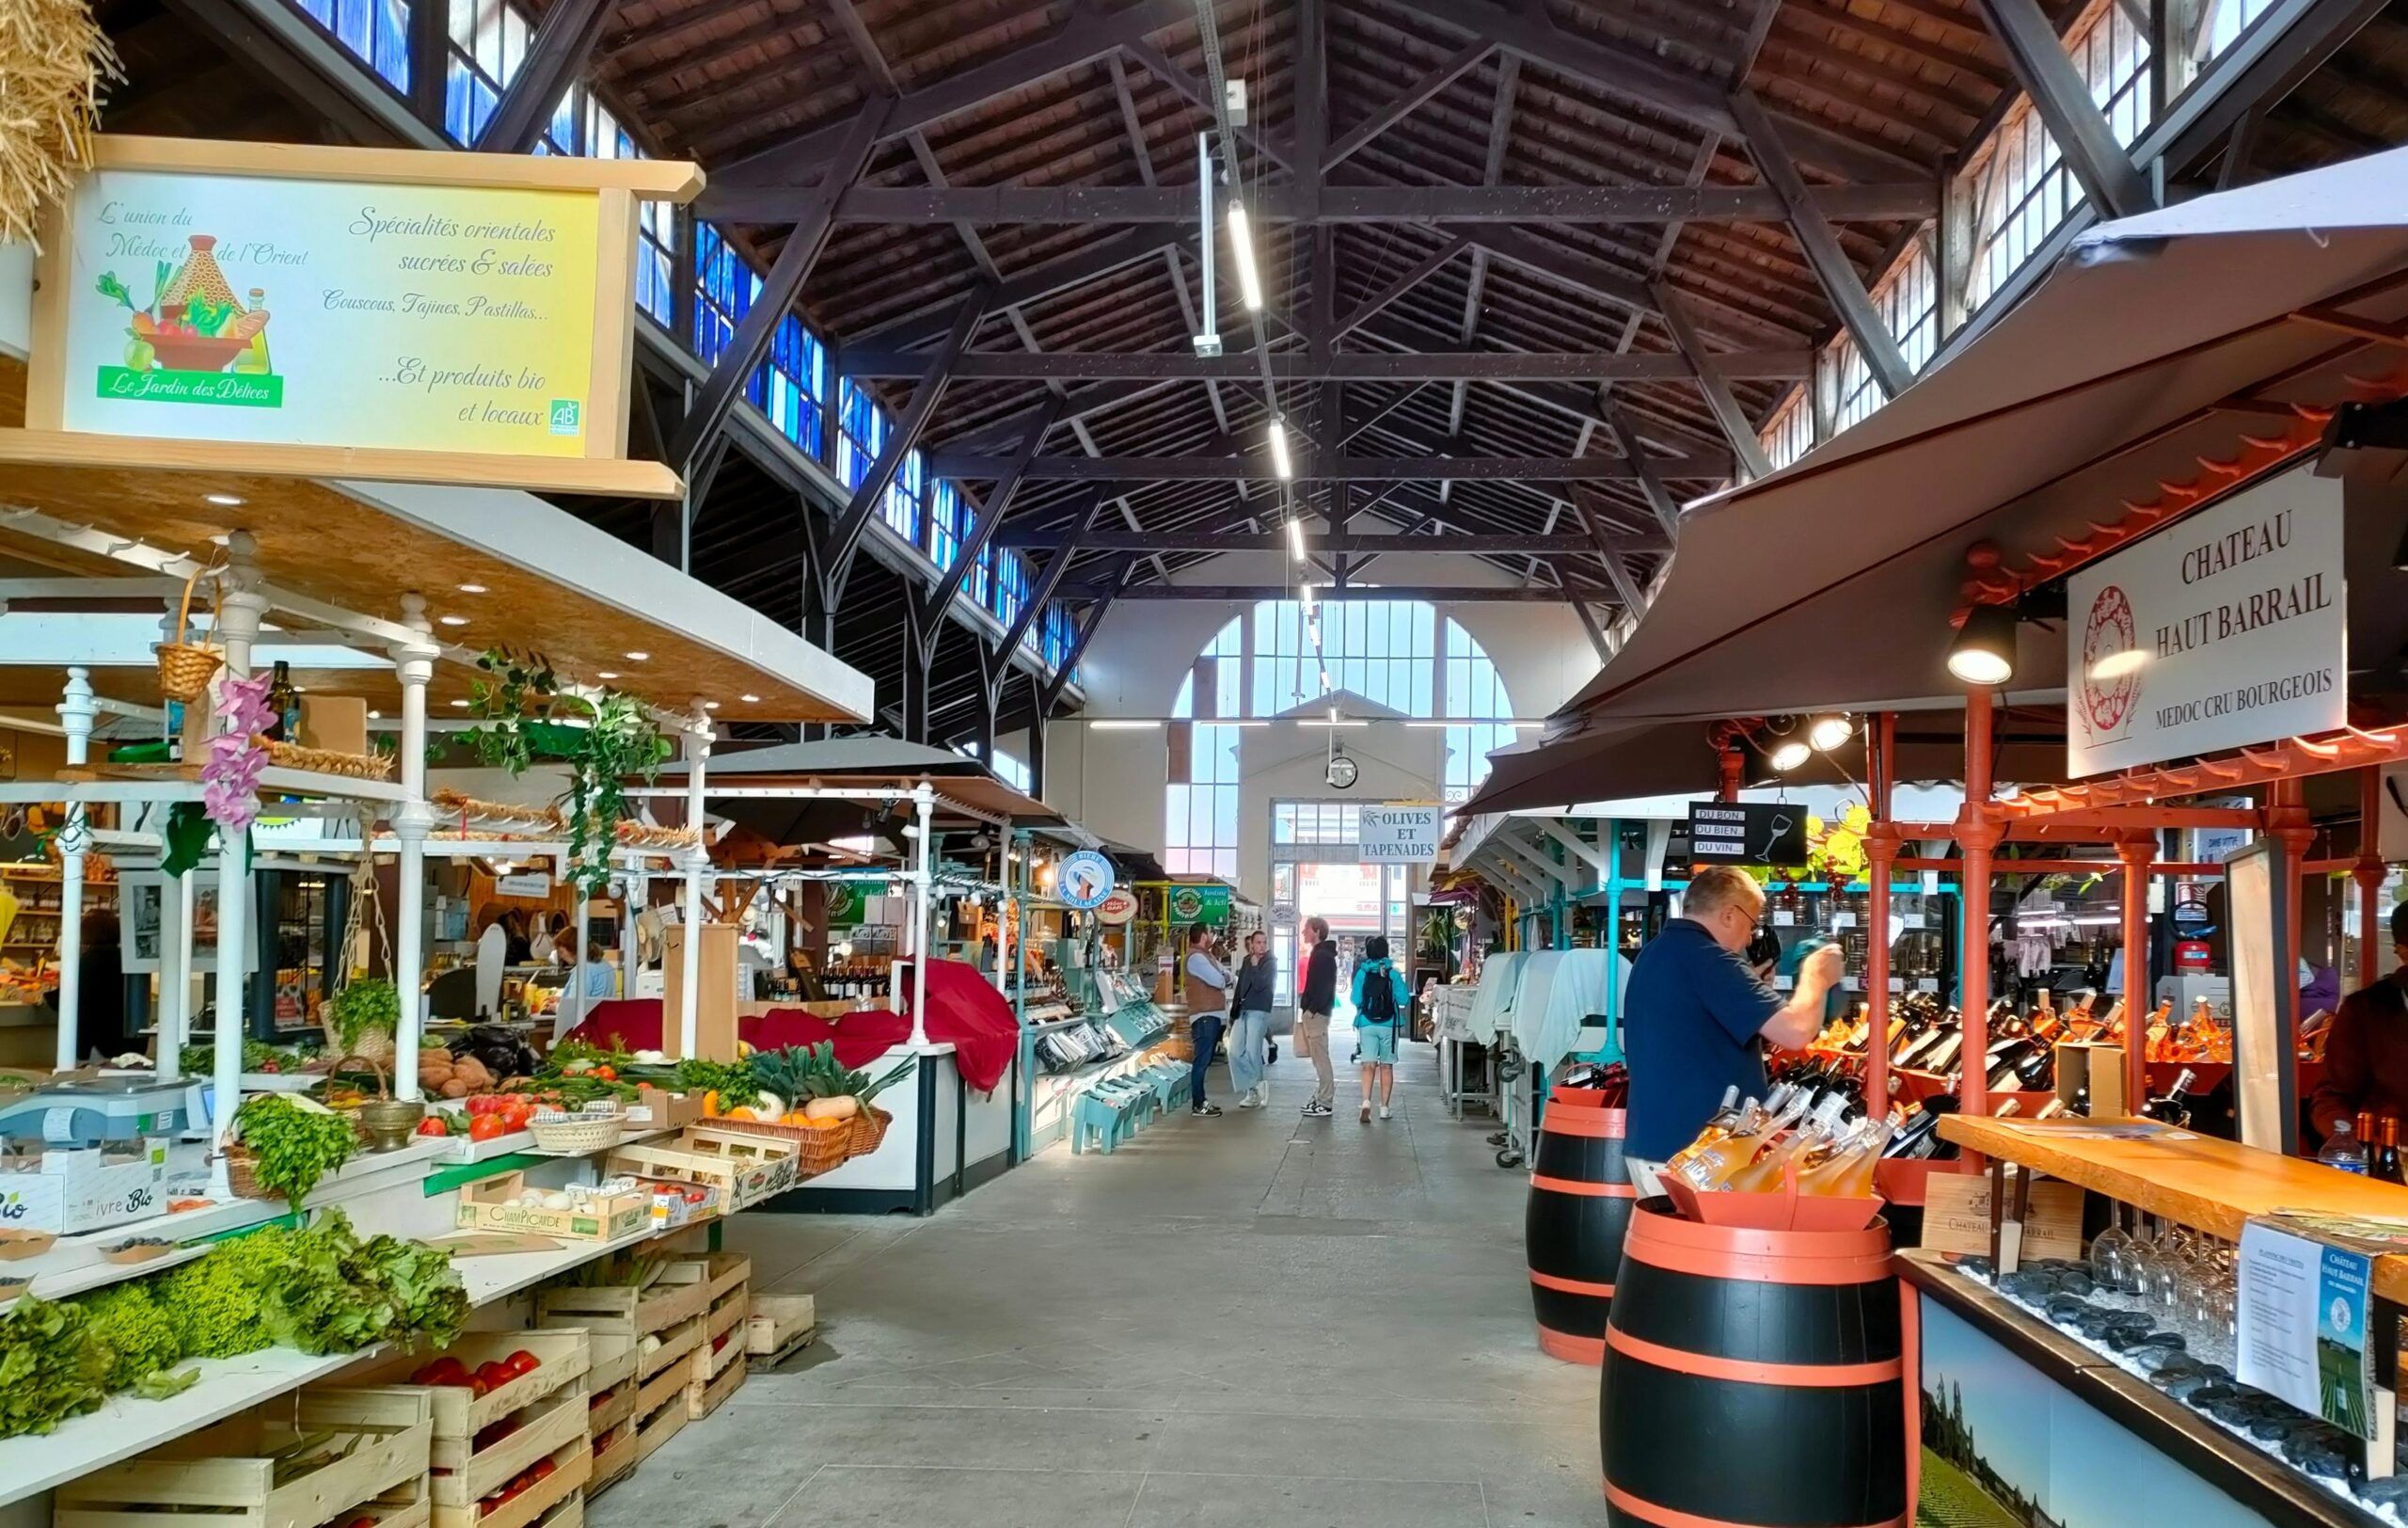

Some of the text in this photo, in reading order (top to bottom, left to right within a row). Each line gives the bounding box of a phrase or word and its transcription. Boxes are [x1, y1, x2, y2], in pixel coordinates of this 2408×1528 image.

[98, 200, 194, 226] L'union du
[349, 206, 556, 243] Spécialités orientales
[105, 232, 309, 265] Médoc et de l'Orient
[398, 249, 553, 278] sucrées & salées
[109, 373, 270, 399] Le Jardin des Délices
[427, 364, 512, 393] produits
[517, 366, 546, 390] bio
[458, 401, 544, 426] et locaux
[2182, 509, 2293, 585] CHATEAU
[2156, 571, 2333, 660] HAUT BARRAIL
[2156, 668, 2333, 729] MEDOC CRU BOURGEOIS
[1382, 812, 1432, 825] OLIVES
[1699, 810, 1715, 820] DU
[1397, 828, 1417, 840] ET
[1696, 825, 1712, 834] DU
[1363, 843, 1434, 857] TAPENADES
[1697, 843, 1712, 852] DU
[0, 1192, 28, 1219] io
